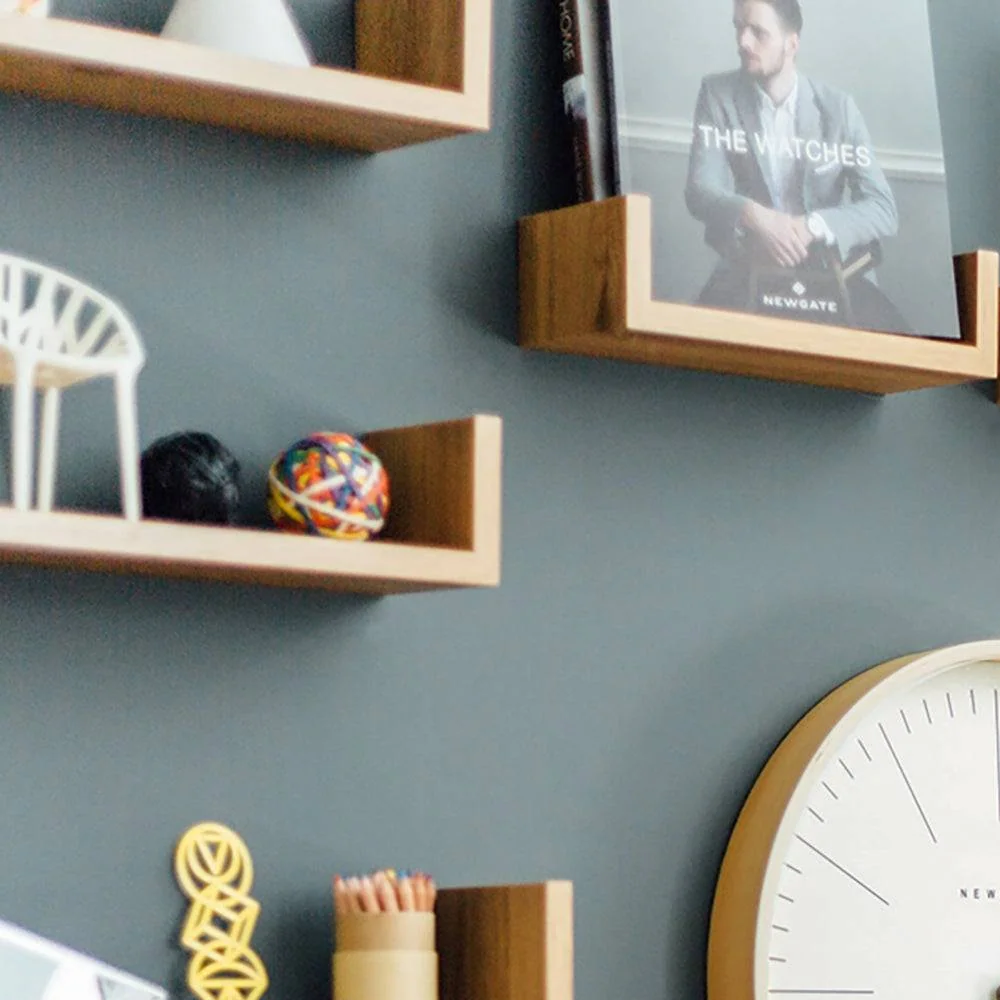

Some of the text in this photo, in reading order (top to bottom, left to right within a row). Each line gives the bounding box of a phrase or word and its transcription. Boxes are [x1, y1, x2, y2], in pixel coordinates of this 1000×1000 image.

[699, 124, 871, 168] THE WATCHES
[763, 294, 838, 313] NEWGATE
